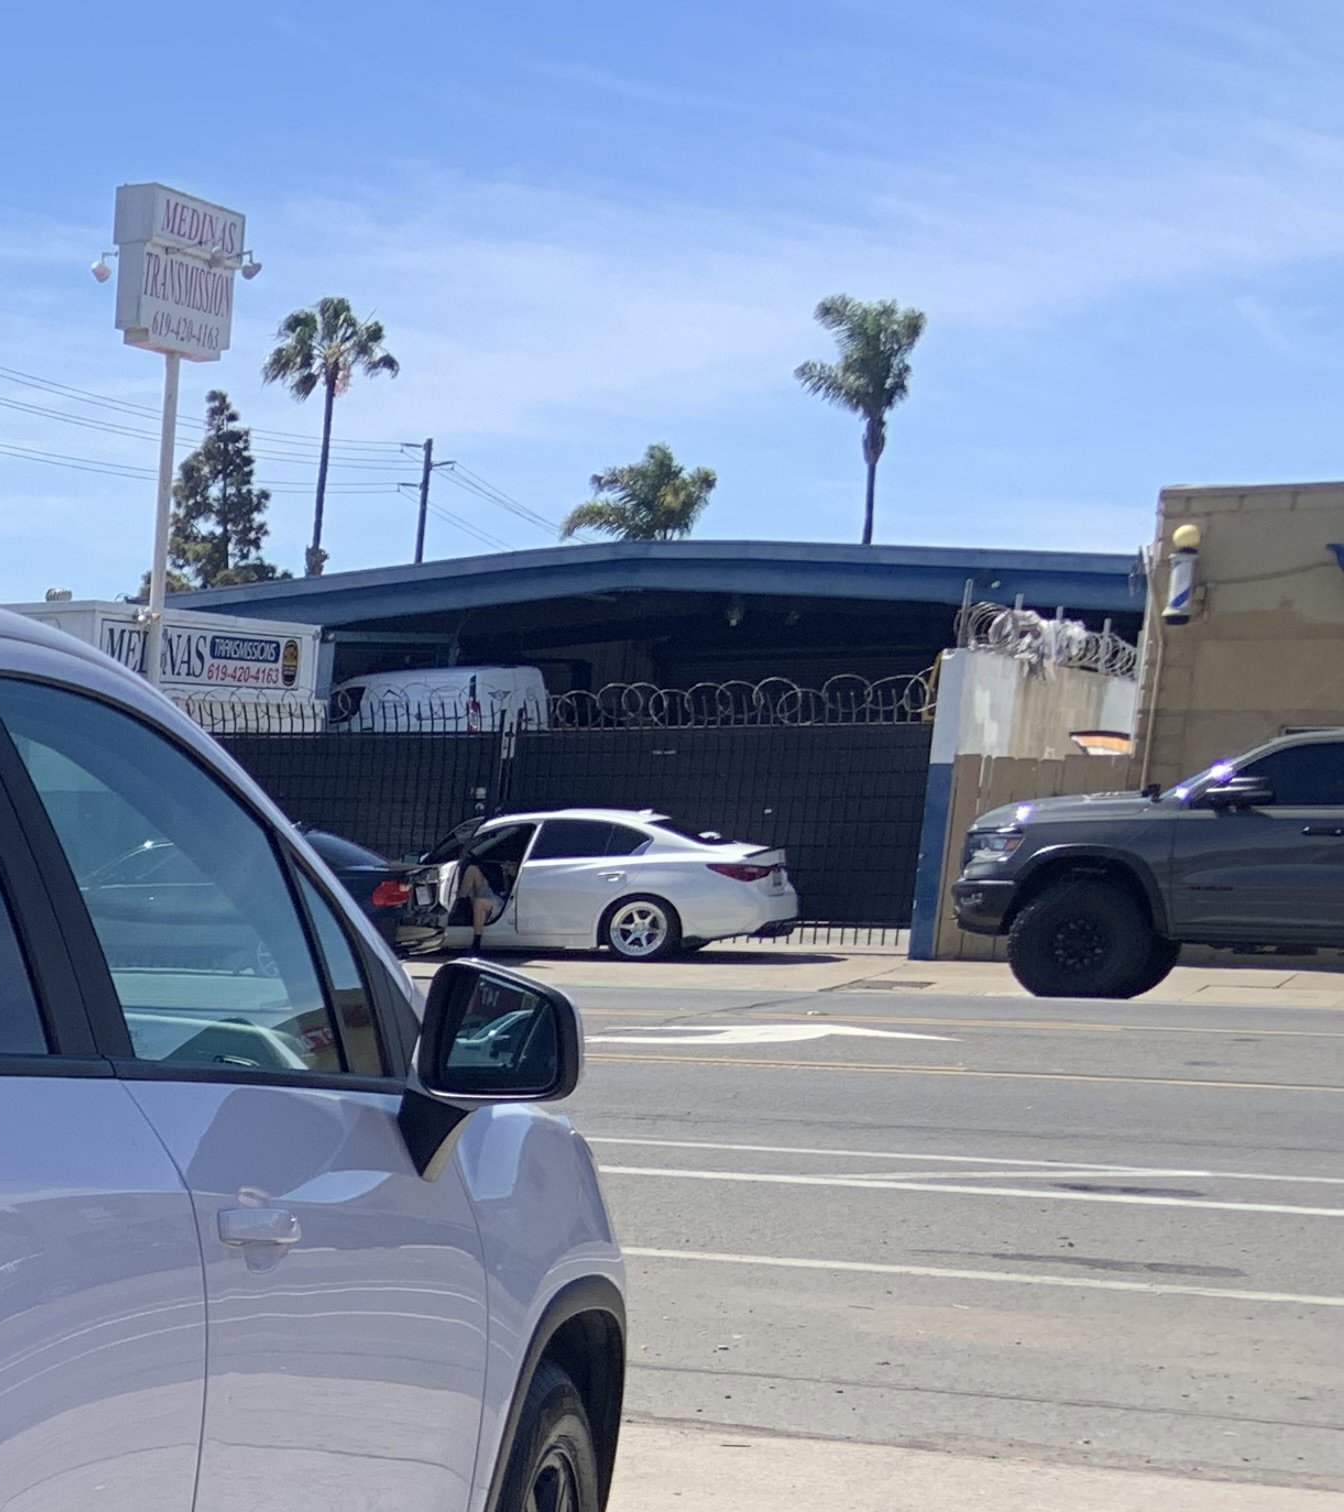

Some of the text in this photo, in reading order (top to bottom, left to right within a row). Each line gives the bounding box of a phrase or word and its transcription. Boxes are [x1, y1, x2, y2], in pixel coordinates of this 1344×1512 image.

[162, 199, 237, 254] MEDINAS
[144, 251, 233, 318] TRANSMISSION
[152, 310, 221, 350] 619-420-4163
[106, 627, 207, 678] MENAS
[214, 638, 277, 660] TRANSMISSIONS
[207, 663, 280, 684] 619-420-4163
